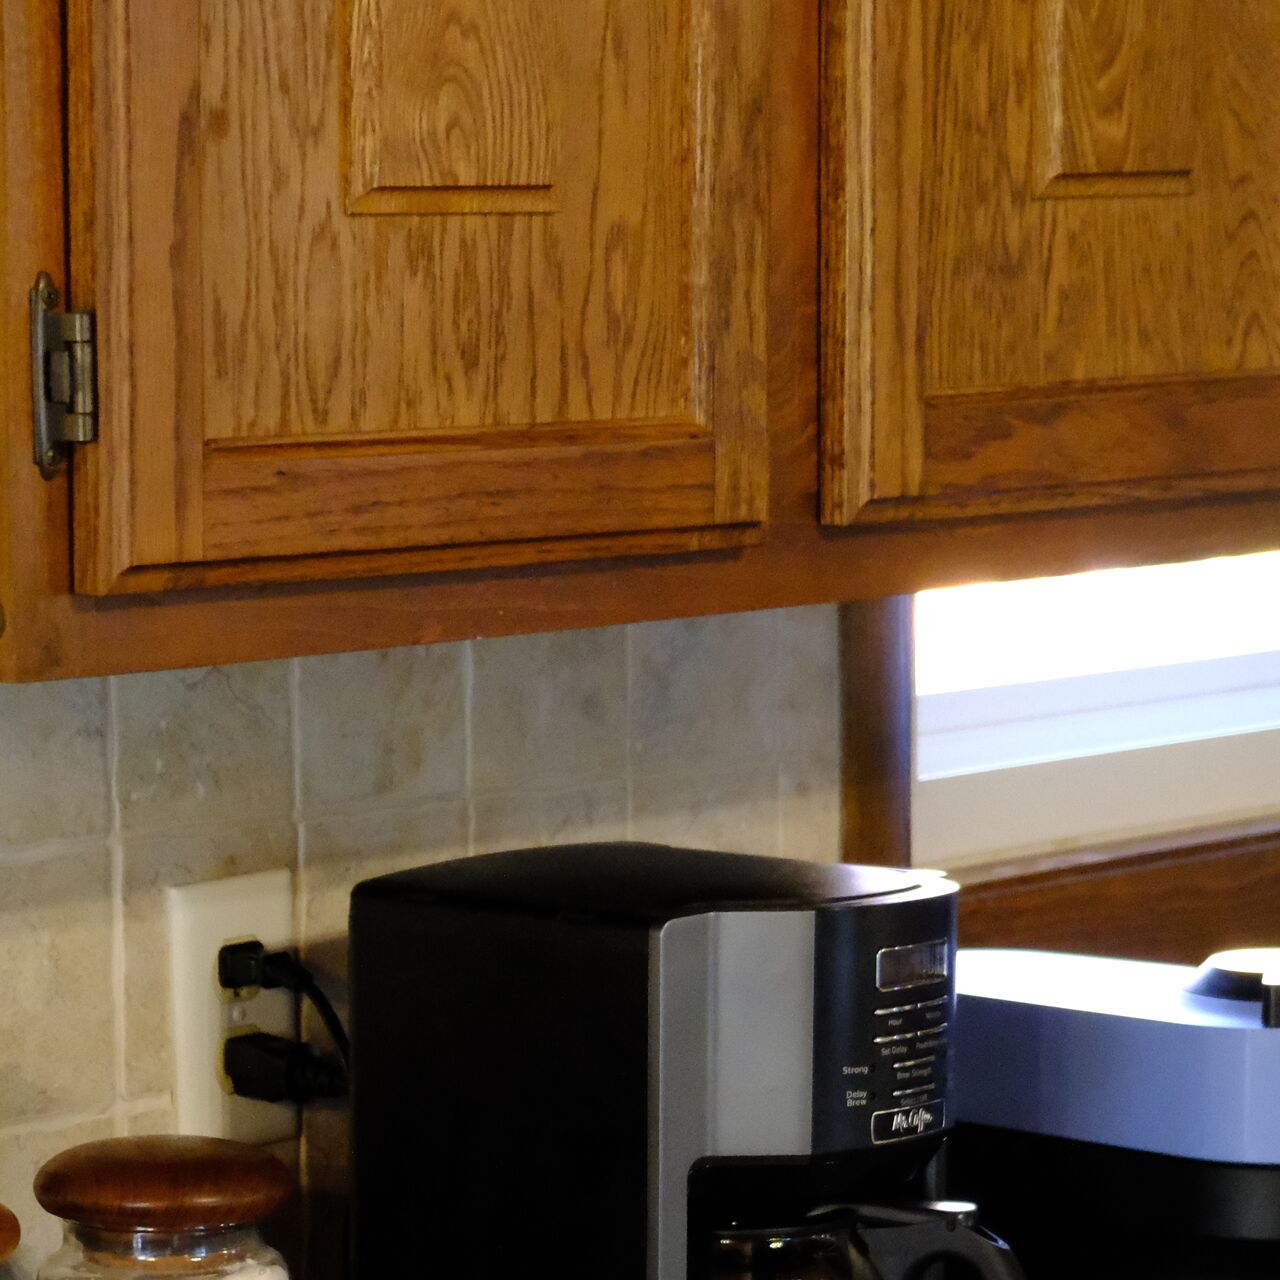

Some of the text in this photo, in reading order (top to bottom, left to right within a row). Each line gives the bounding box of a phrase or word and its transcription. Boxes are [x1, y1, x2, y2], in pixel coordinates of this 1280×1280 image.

[842, 1066, 869, 1075] Strong
[846, 1090, 867, 1099] Delay
[847, 1099, 867, 1107] Brew
